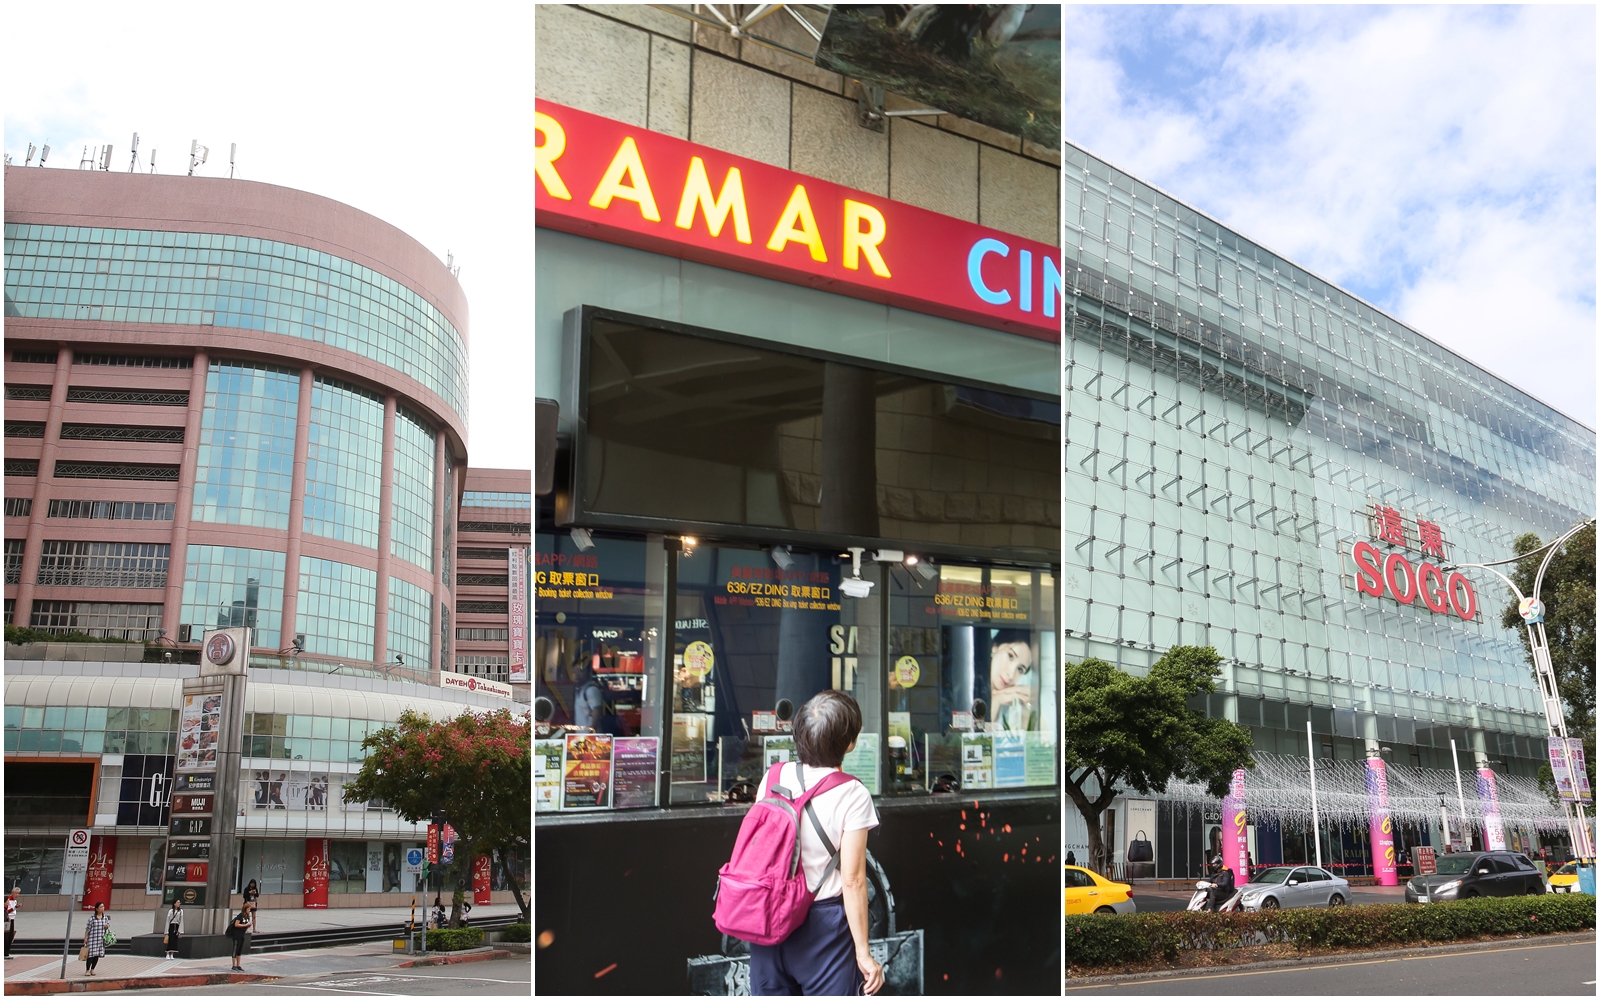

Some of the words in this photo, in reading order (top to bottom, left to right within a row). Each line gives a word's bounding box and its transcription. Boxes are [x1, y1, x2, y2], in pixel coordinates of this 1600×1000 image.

[1374, 504, 1445, 559] 遠東
[1352, 541, 1476, 620] SOGO
[573, 588, 594, 599] collection
[595, 590, 613, 599] window
[727, 581, 763, 595] 636/EZ
[764, 583, 789, 597] DING
[934, 594, 964, 606] 636/EZ
[965, 596, 984, 607] DING
[511, 602, 523, 663] 玫瑰寶寶卡
[445, 677, 467, 688] DAYEH
[476, 681, 510, 698] Takashimaya
[191, 798, 206, 806] MUJI
[189, 820, 204, 833] GAP
